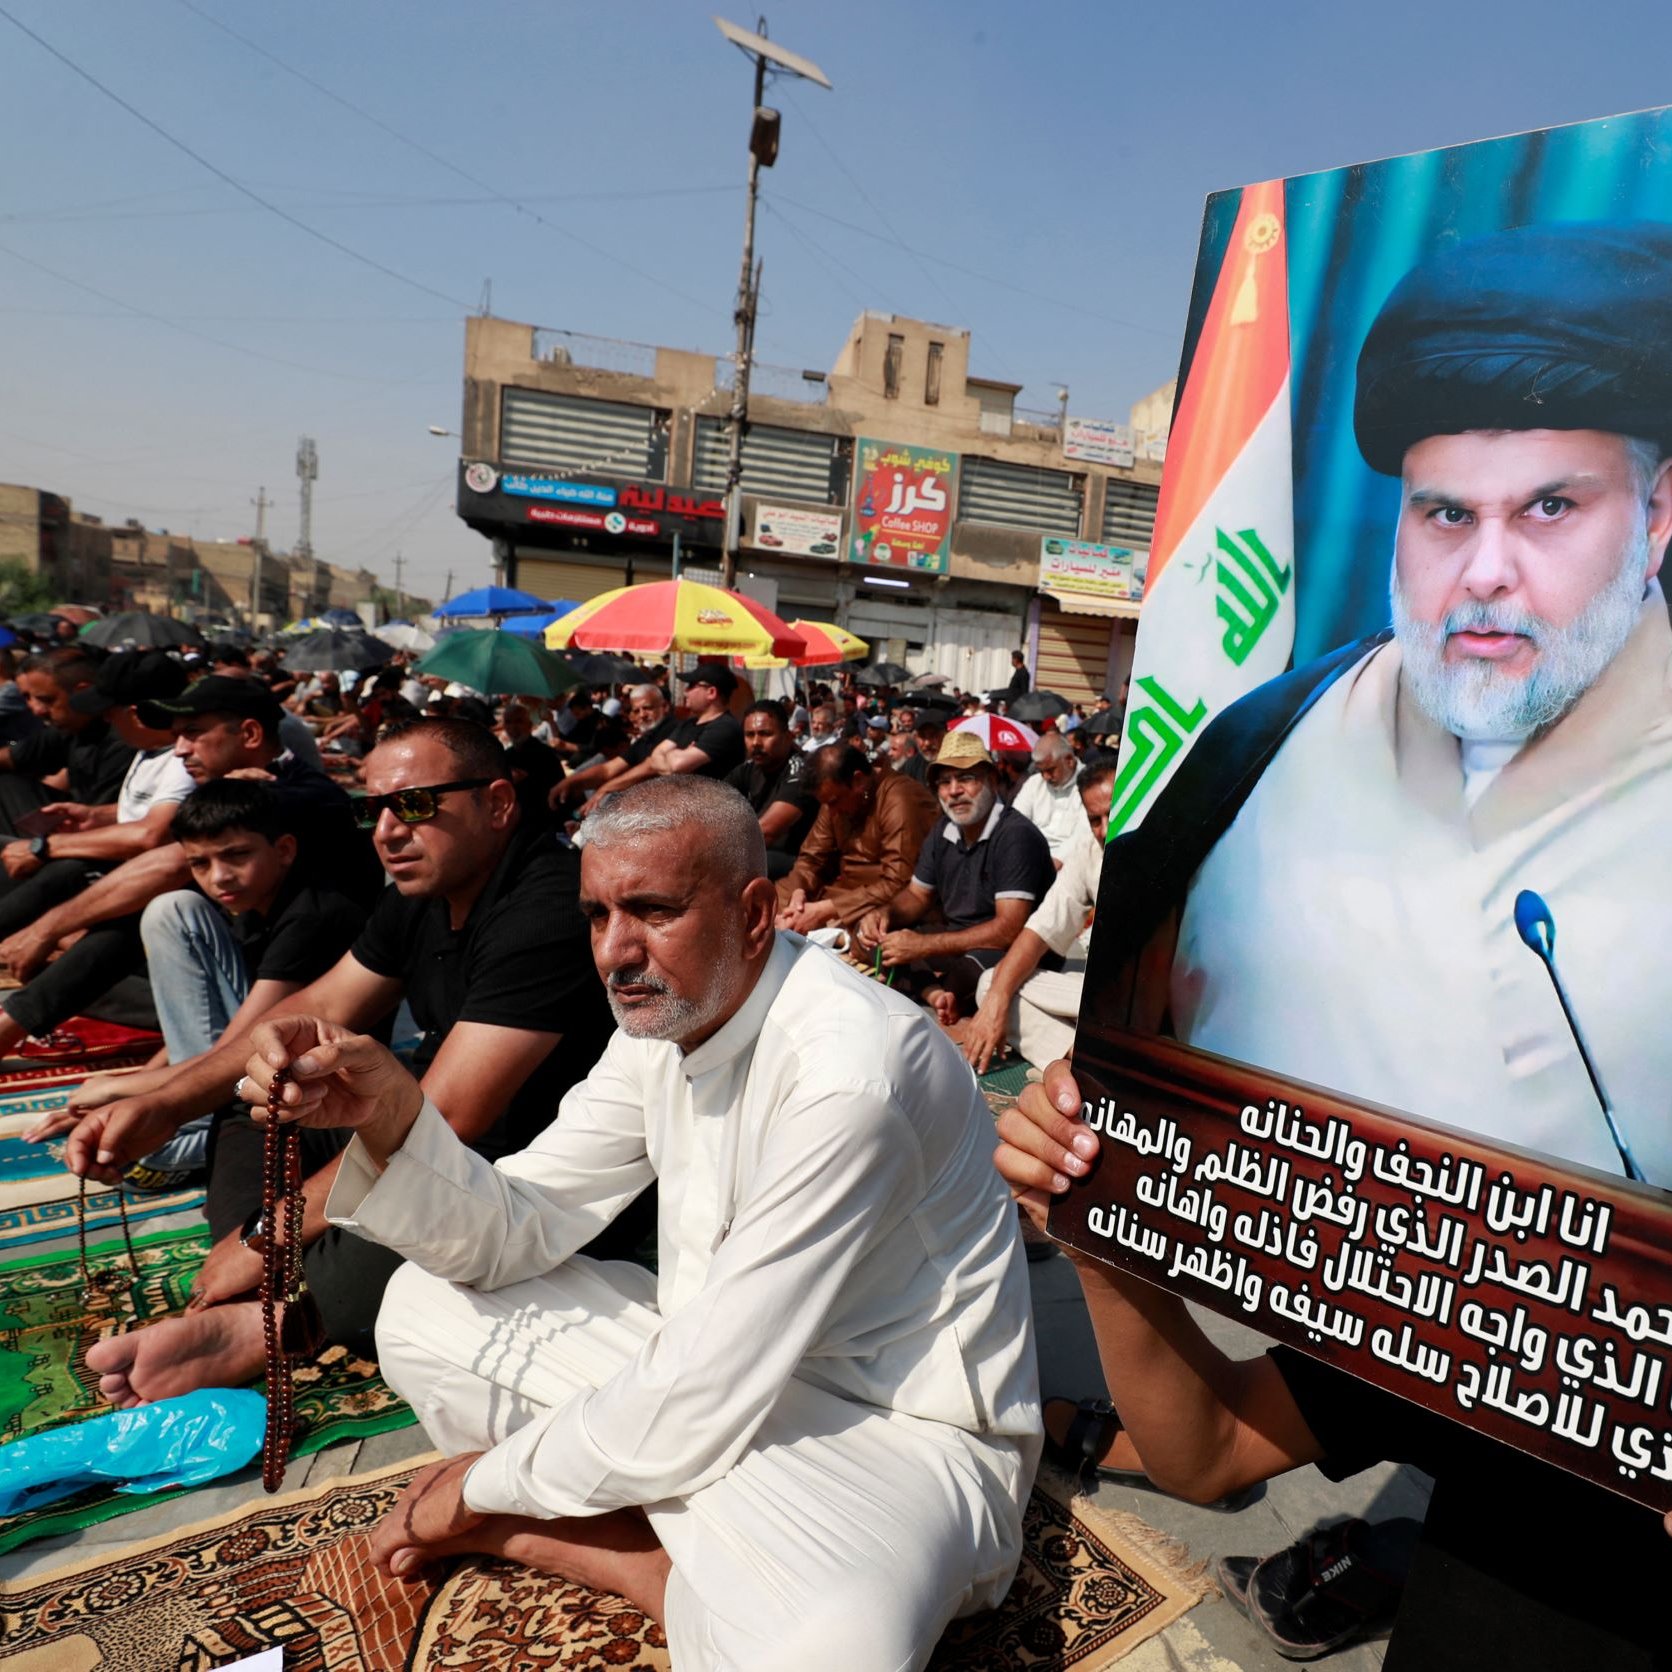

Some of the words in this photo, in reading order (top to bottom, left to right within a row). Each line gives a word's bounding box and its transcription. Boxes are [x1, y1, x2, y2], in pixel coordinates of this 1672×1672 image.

[881, 448, 911, 468] شوب
[914, 456, 951, 474] كوفي
[619, 484, 727, 520] صيدلية
[883, 472, 946, 515] كرز
[881, 515, 911, 531] Coffee
[912, 519, 939, 535] SHOP
[1240, 1101, 1367, 1181] والحنانه
[1194, 1143, 1290, 1202] الظلم
[1373, 1142, 1483, 1211] النجف
[1087, 1203, 1167, 1261] سنانه
[1136, 1171, 1228, 1242] واهانه
[1292, 1177, 1368, 1241] رفض
[1486, 1176, 1553, 1239] ابن
[1559, 1195, 1610, 1253] انا
[1234, 1210, 1318, 1269] فاذله
[1375, 1207, 1465, 1266] الذي
[1167, 1242, 1263, 1313] واظهر
[1323, 1241, 1454, 1324] الاحتلال
[1463, 1243, 1588, 1311] الصدر
[1268, 1284, 1364, 1346] سيفه
[1460, 1303, 1547, 1371] واجه
[1592, 1288, 1672, 1346] حمد
[1371, 1325, 1450, 1383] سله
[1556, 1337, 1662, 1406] الذي
[1456, 1364, 1605, 1447] للاصلاح
[1611, 1425, 1672, 1481] ذي
[1321, 1555, 1352, 1583] NIKE
